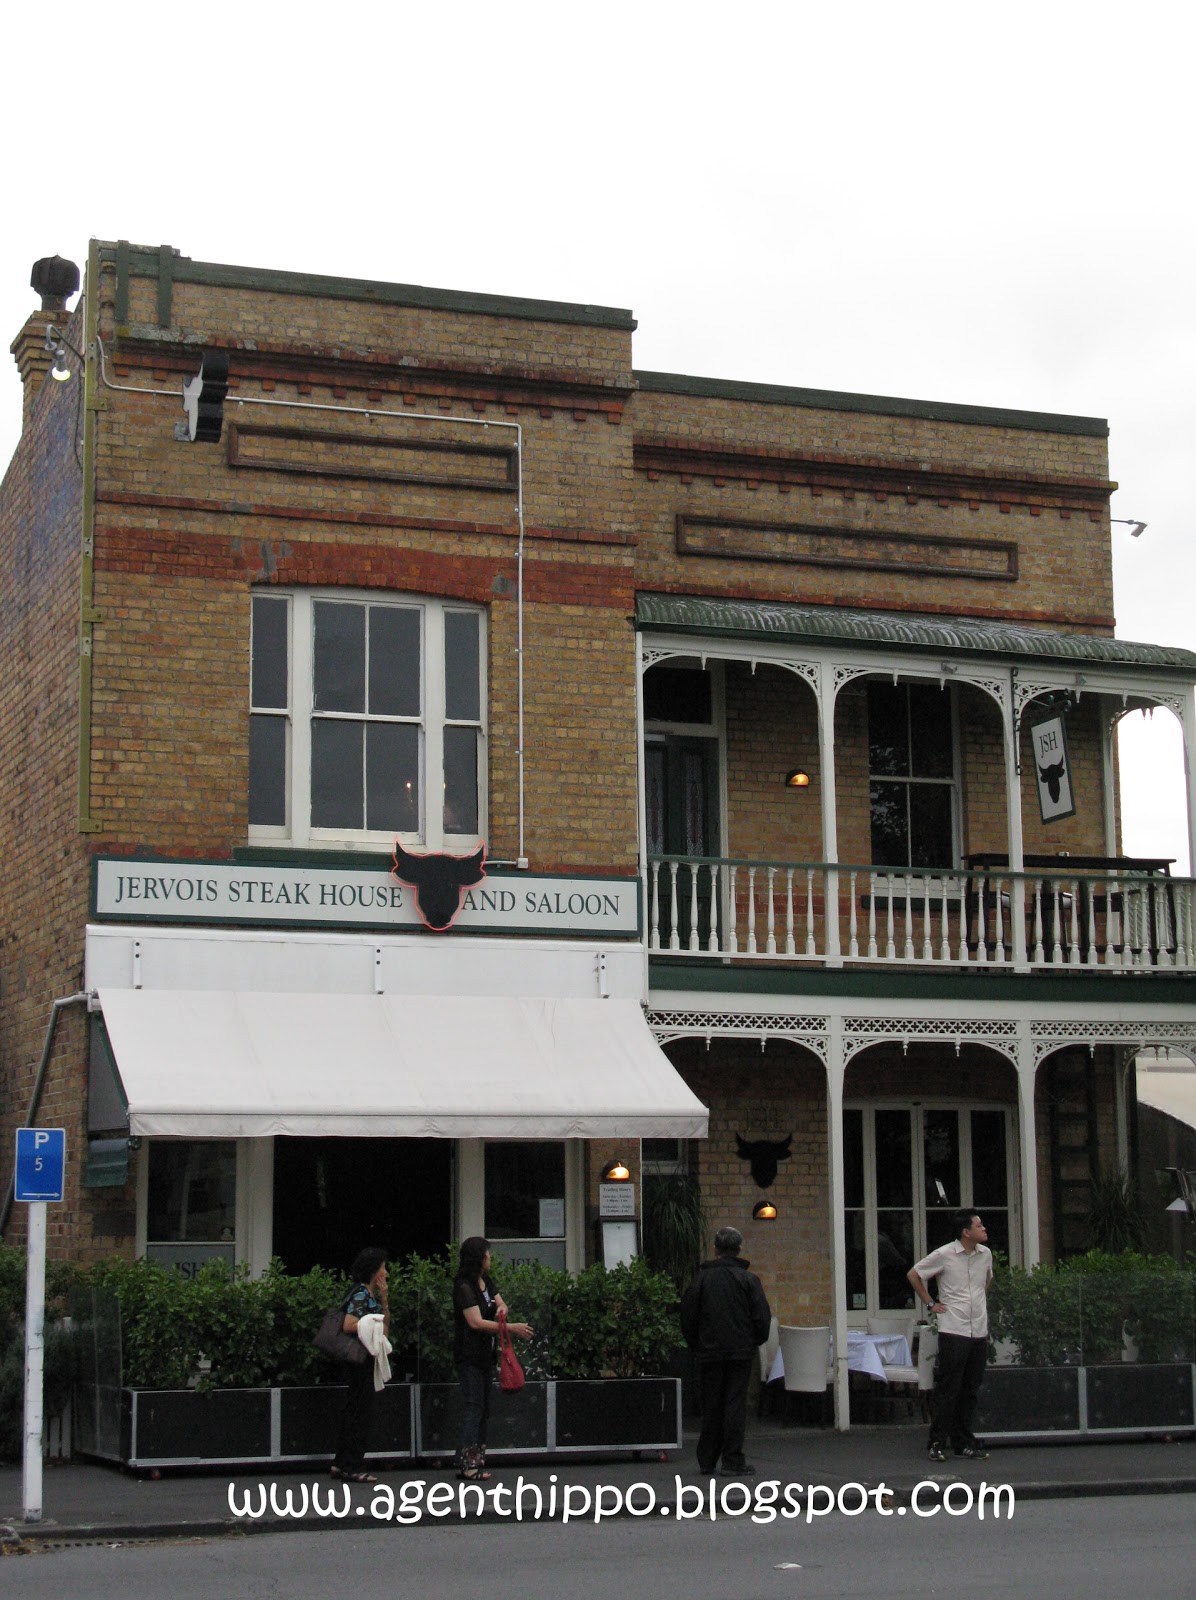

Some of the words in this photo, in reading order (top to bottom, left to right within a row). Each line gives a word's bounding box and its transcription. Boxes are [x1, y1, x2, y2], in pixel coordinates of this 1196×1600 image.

[1039, 731, 1058, 758] JSH
[115, 876, 218, 903] JERVOIS
[228, 880, 311, 904] STEAK
[319, 884, 403, 908] HOUSE
[461, 889, 516, 912] AND
[525, 891, 620, 915] SALOON
[35, 1131, 50, 1149] P
[35, 1157, 43, 1171] 5
